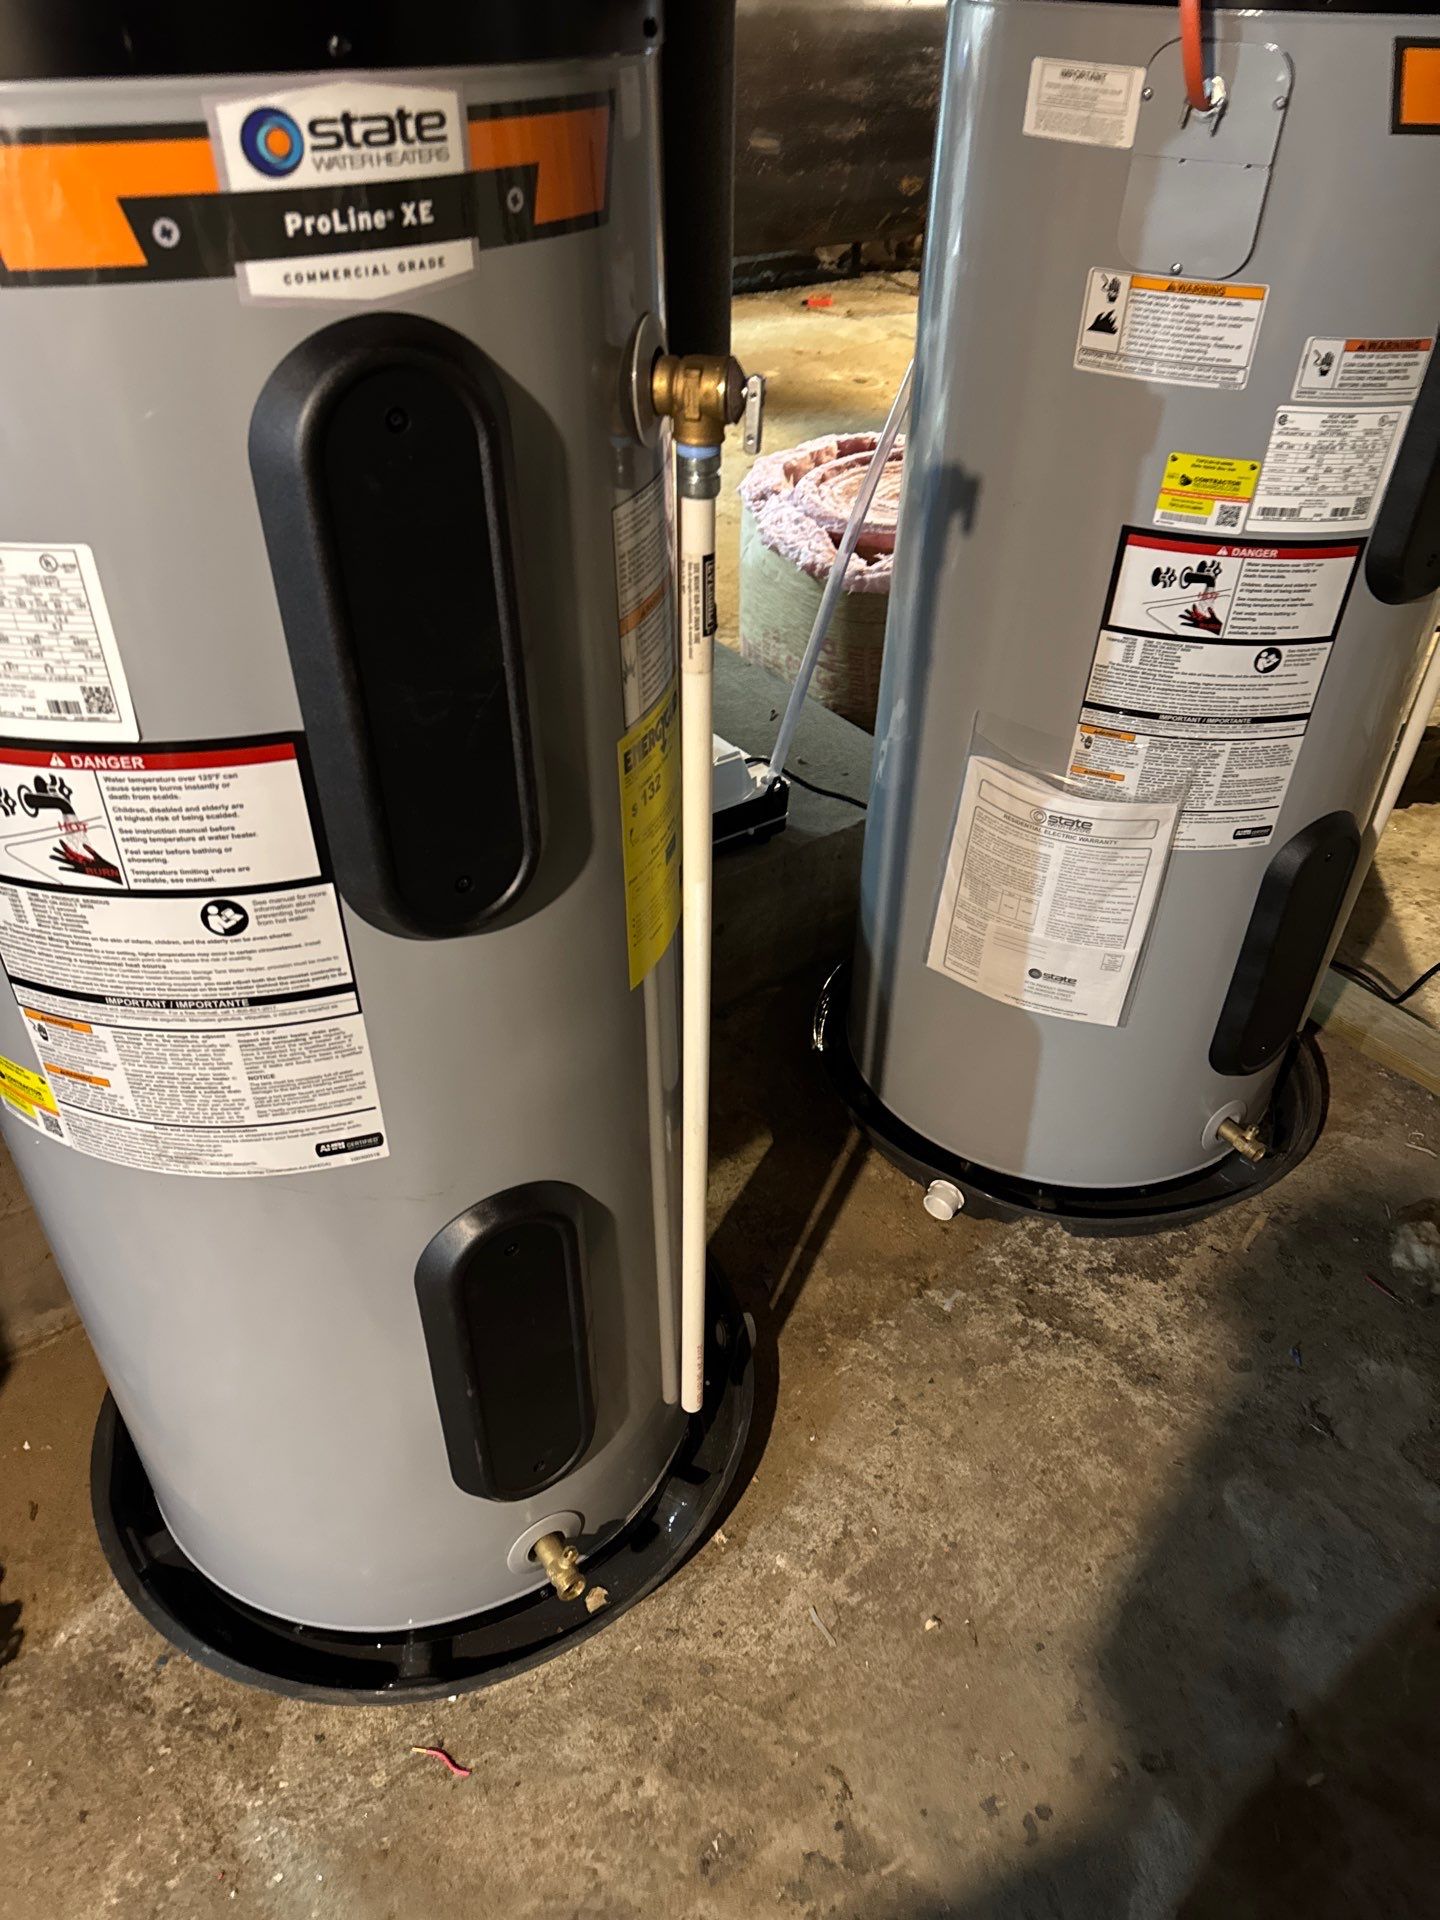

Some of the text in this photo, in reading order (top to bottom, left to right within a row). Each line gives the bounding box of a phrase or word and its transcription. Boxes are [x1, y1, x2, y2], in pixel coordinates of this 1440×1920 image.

[307, 106, 447, 151] state
[312, 147, 450, 171] WATER HEATERS
[401, 200, 434, 227] XE
[284, 256, 445, 286] COMMERCIAL GRADE
[1179, 283, 1226, 296] WARNING
[1368, 341, 1421, 351] WARNING
[1194, 476, 1241, 486] CONTRACTOR
[1231, 549, 1279, 557] DANGER
[1159, 714, 1201, 722] IMPORTANT
[70, 755, 145, 769] DANGER
[128, 776, 176, 784] temperature
[641, 773, 661, 807] 132
[124, 815, 153, 823] highest
[182, 814, 204, 822] being
[1048, 814, 1093, 830] state
[58, 822, 88, 833] HOT
[1003, 813, 1118, 845] RESIDENTIAL ELECTRIC WARRANTY
[85, 867, 118, 877] BURN
[131, 869, 177, 877] Temperature
[180, 868, 209, 876] limiting
[269, 896, 296, 904] manual
[254, 903, 293, 913] information
[256, 910, 293, 919] preventing
[1043, 972, 1077, 983] state
[105, 997, 249, 1009] IMPORTANT / IMPORTANTE
[346, 1136, 379, 1148] CERTIFIED
